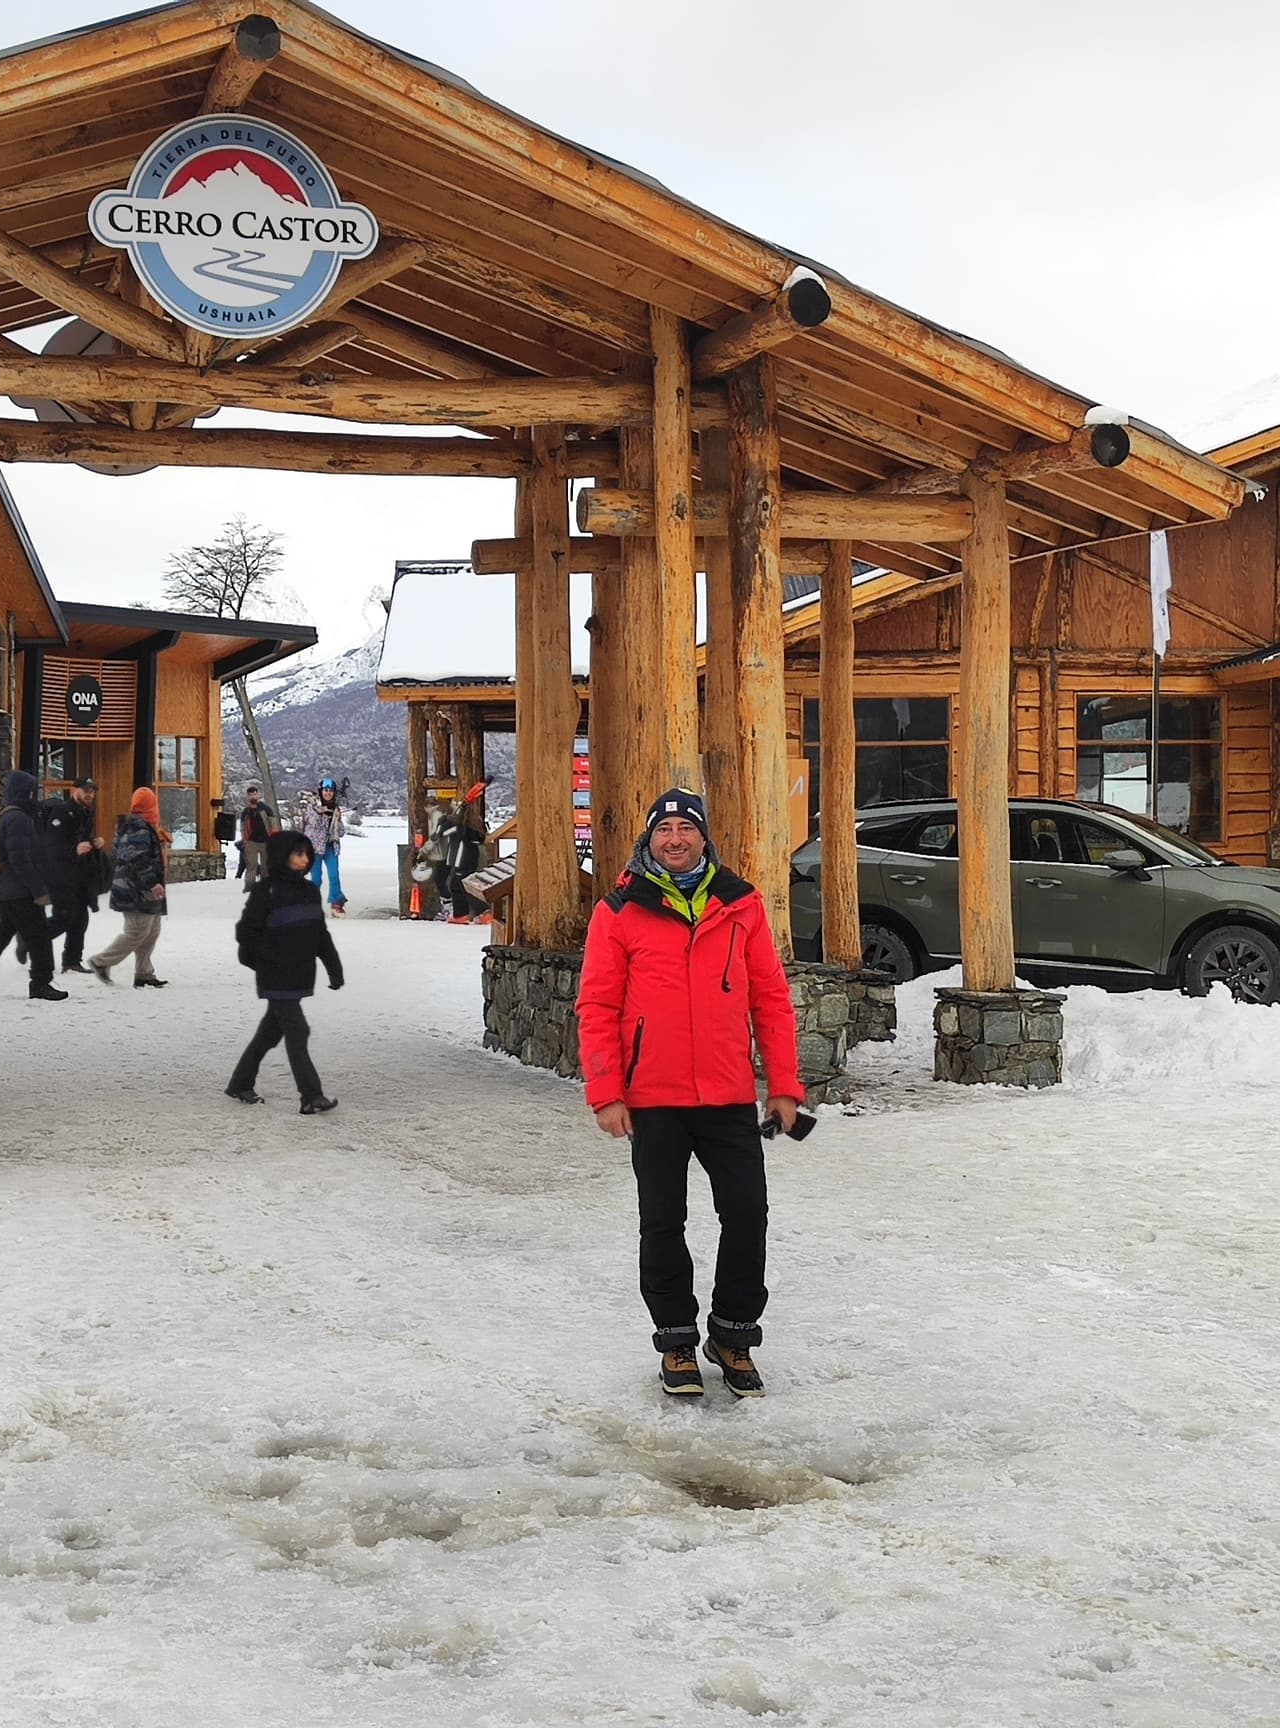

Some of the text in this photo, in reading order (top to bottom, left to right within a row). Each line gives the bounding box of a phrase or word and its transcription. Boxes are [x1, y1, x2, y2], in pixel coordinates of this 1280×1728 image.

[152, 129, 316, 188] TIERRA DEL FUEGO
[108, 204, 364, 245] CERRO CASTOR
[198, 303, 276, 323] USHUAIA
[72, 692, 98, 706] ONA
